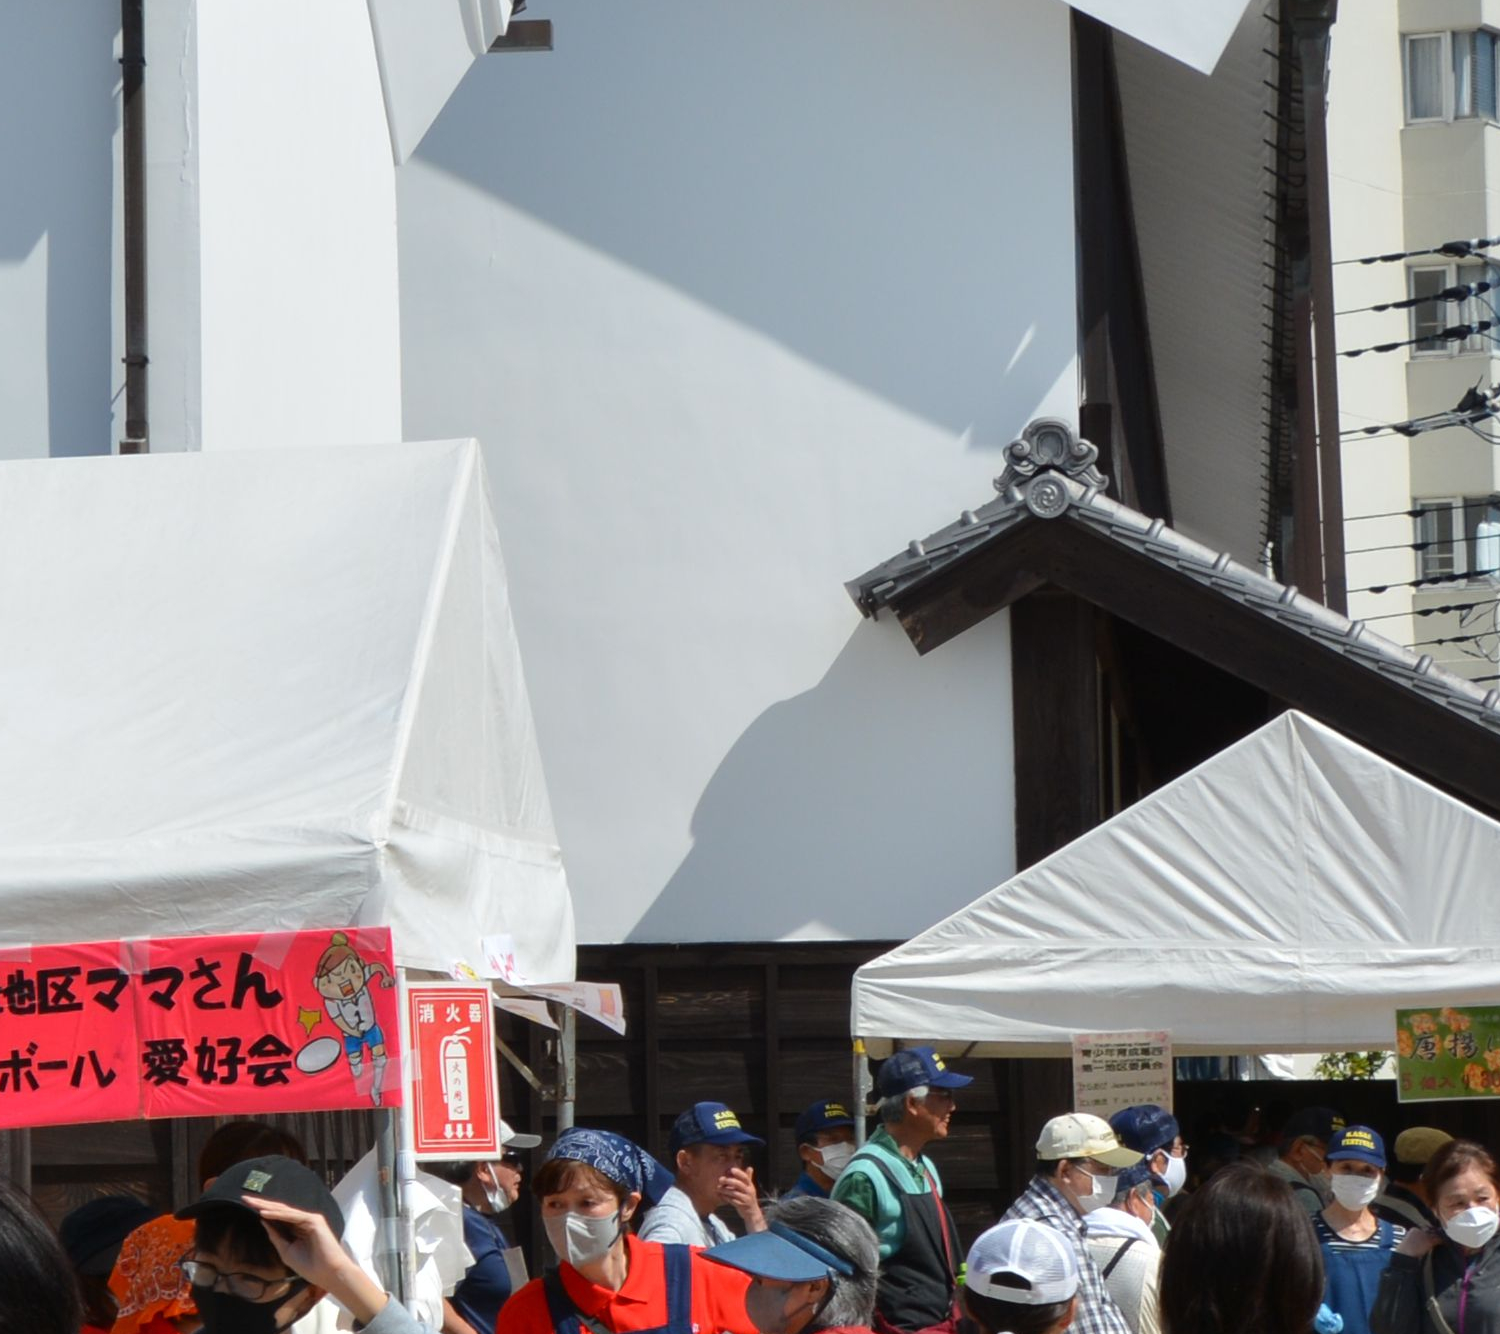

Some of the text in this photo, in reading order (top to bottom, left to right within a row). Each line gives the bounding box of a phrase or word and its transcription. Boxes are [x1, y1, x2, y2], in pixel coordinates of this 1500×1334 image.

[419, 1003, 482, 1023] 消火器
[142, 1032, 294, 1087] 愛好会
[452, 1061, 464, 1115] 火の用心
